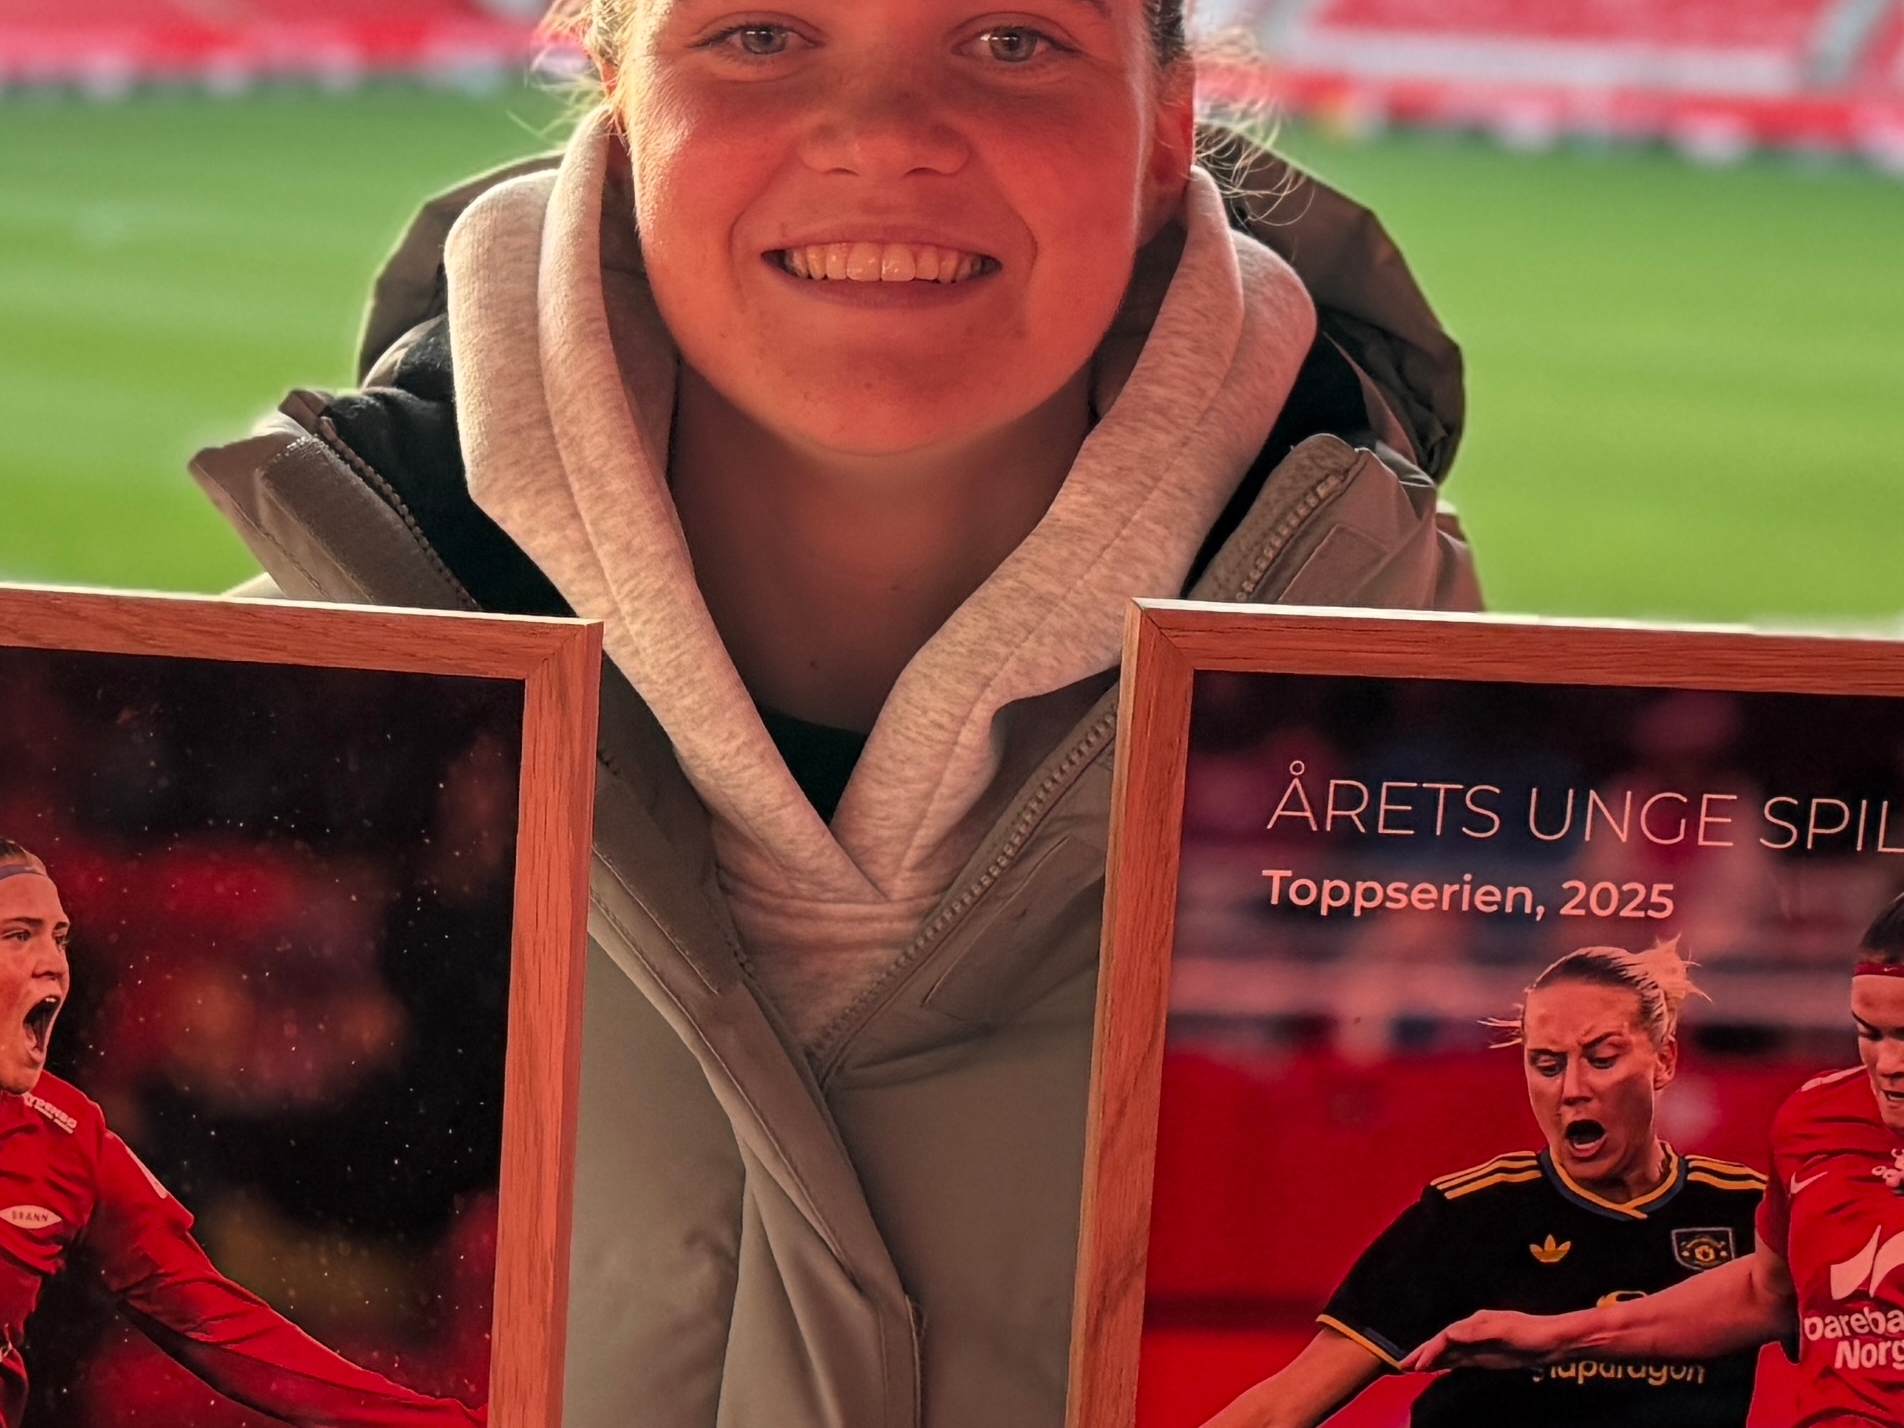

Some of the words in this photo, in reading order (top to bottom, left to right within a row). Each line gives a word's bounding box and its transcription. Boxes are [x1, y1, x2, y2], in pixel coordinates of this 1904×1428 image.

[1265, 760, 1501, 838] ÅRETS
[1527, 787, 1738, 847] UNGE
[1261, 869, 1546, 921] Toppserien,
[1559, 879, 1675, 921] 2025
